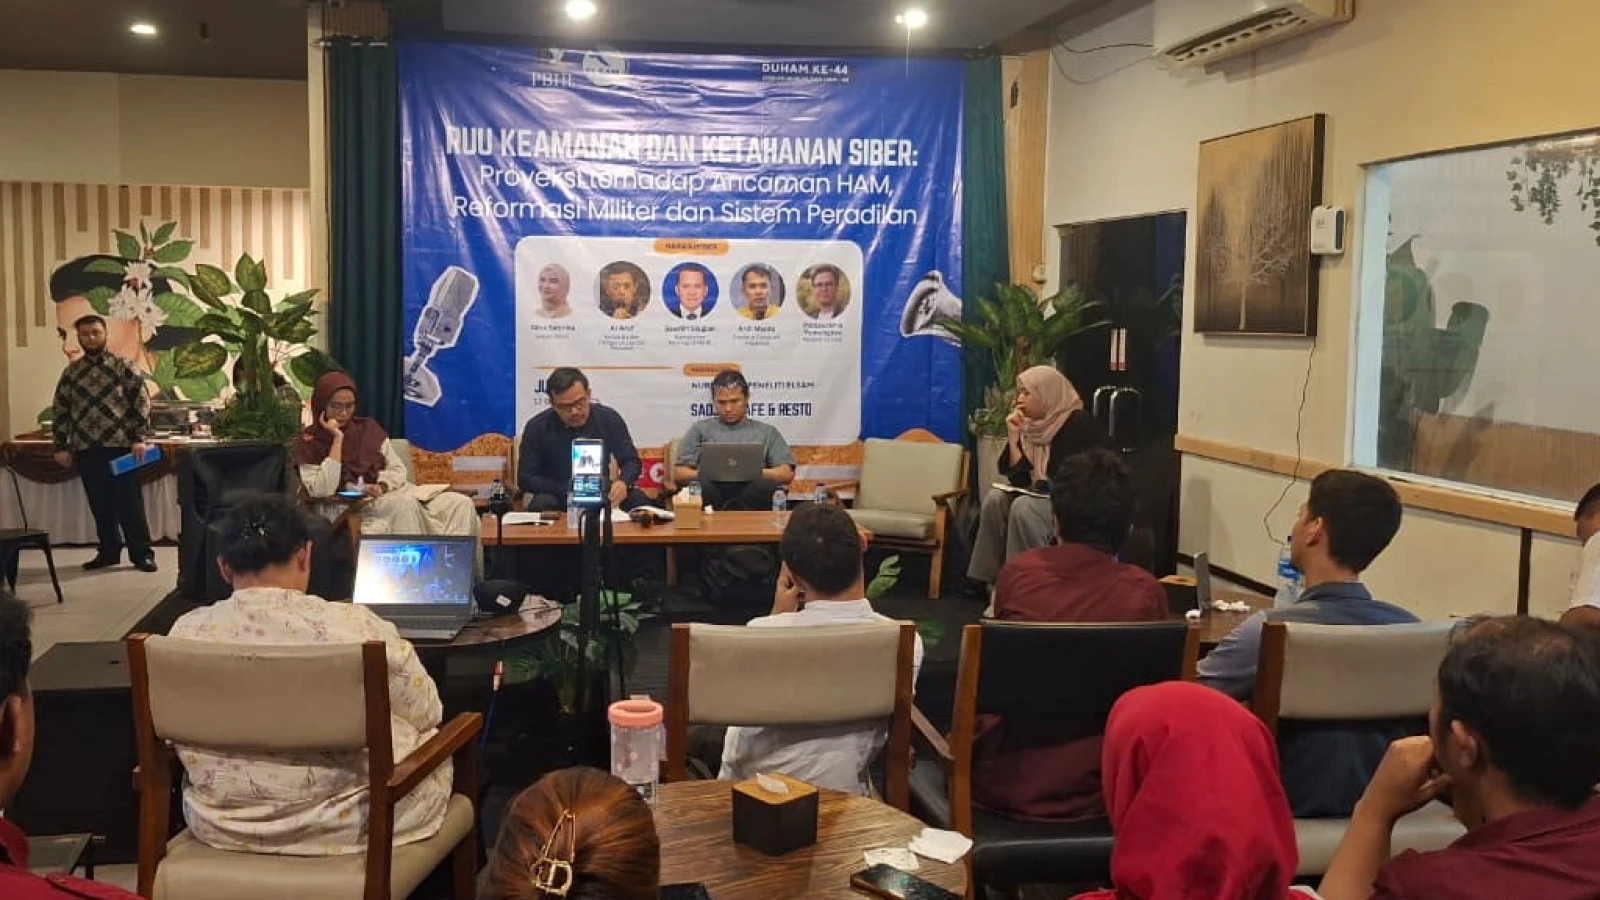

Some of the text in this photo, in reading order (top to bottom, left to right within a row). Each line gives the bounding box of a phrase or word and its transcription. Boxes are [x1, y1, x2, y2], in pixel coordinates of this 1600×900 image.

[446, 126, 919, 167] RUU KEAMANAN DAN KETAHANAN SIBER:
[481, 165, 583, 193] Proyeksi
[711, 173, 830, 194] Ancaman
[837, 175, 894, 198] HAM,
[455, 196, 917, 225] Reformasi Militer dan Sistem Peradilan
[778, 403, 812, 417] RESTO
